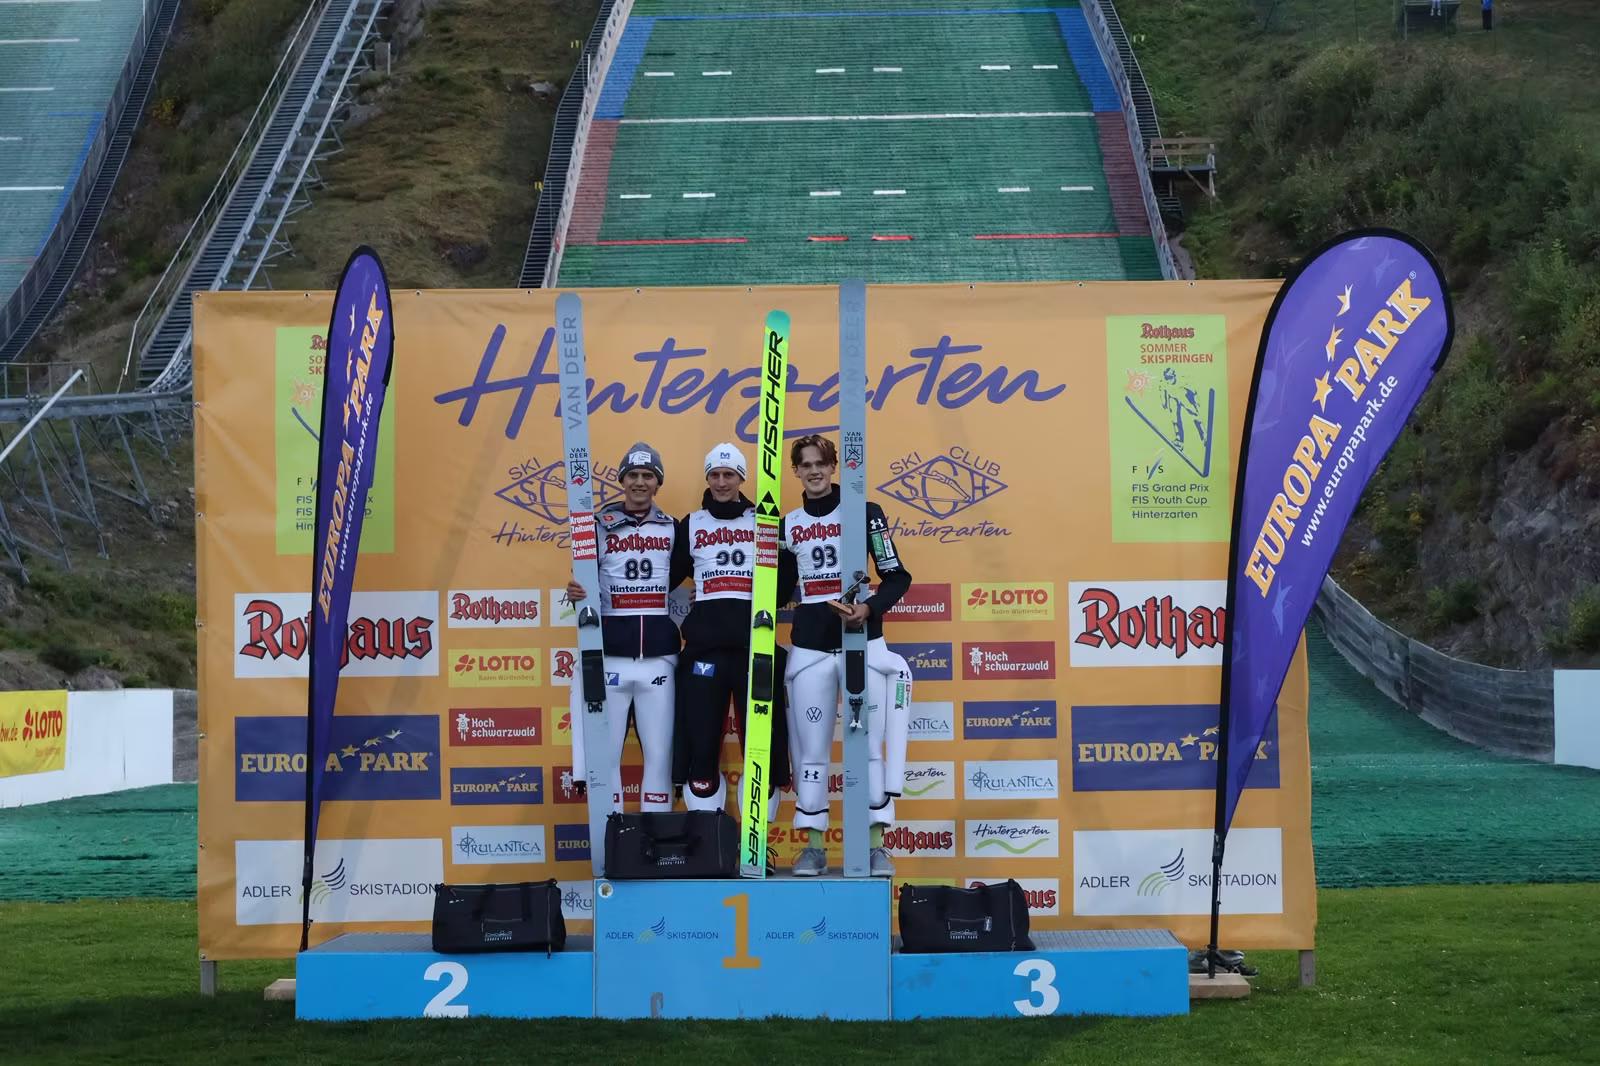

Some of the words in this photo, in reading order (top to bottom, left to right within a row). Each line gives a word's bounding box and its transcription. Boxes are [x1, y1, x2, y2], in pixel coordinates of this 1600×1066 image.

[1140, 323, 1195, 341] Rothaus
[563, 316, 580, 375] DEER
[1141, 343, 1187, 353] SOMMER
[1141, 353, 1214, 364] SKISPRINGEN
[434, 323, 1067, 443] Hnterzarten
[566, 385, 583, 430] VAN
[763, 330, 784, 481] FISCHER
[1244, 414, 1342, 598] EUROPA
[1334, 278, 1432, 403] PARK
[319, 439, 355, 623] EUROPA
[351, 291, 383, 423] PARK
[889, 451, 922, 475] SKI
[949, 445, 1001, 477] CLUB
[1301, 375, 1398, 547] www.europapark.de
[508, 457, 541, 480] SKI
[593, 462, 618, 482] UB
[339, 393, 374, 571] www.europapark.de
[1132, 483, 1149, 492] FIS
[1152, 483, 1185, 492] Grand
[1189, 483, 1209, 492] Prix
[296, 496, 313, 504] FIS
[1132, 495, 1149, 504] FIS
[1153, 495, 1182, 504] Youth
[1185, 495, 1208, 507] Cup
[296, 508, 313, 516] FIS
[1132, 509, 1198, 519] Hinterzarten
[570, 514, 594, 526] Kronen
[491, 521, 571, 549] Hinterz
[571, 524, 595, 534] Zeitung
[757, 525, 778, 535] Kronen
[572, 538, 595, 549] Kronen
[605, 533, 671, 554] Rothaus
[694, 527, 755, 550] Rothau
[573, 547, 597, 557] Zeitung
[756, 547, 777, 556] Kronen
[812, 544, 839, 570] 93
[624, 558, 653, 581] 89
[802, 571, 842, 581] Hinterzar
[610, 585, 666, 593] Hinterzarten
[992, 589, 1048, 605] LOTTO
[451, 593, 538, 624] Rothaus
[240, 599, 434, 671] Roaus
[479, 656, 535, 671] LOTTO
[916, 658, 948, 668] PARK
[985, 651, 1008, 661] Hoch
[985, 661, 1049, 671] schwarzwald
[35, 710, 62, 739] LOTTO
[471, 717, 494, 727] Hoch
[966, 718, 1012, 728] EUROPA
[1020, 717, 1052, 727] PARK
[0, 722, 18, 742] bw.de
[471, 727, 535, 737] schwarzwald
[1078, 742, 1182, 762] EUROPA
[1199, 741, 1268, 760] PK
[241, 753, 343, 772] EUROA
[360, 752, 429, 771] PARK
[453, 783, 499, 793] EUROPA
[507, 783, 538, 792] PARK
[982, 775, 1054, 790] RULANTICA
[748, 760, 762, 867] FISCHER
[790, 827, 843, 843] LOTO
[973, 823, 1051, 838] Hinterzarten
[470, 840, 542, 855] RULANTICA
[557, 840, 592, 849] EURO
[880, 826, 953, 854] othaus
[1080, 876, 1130, 888] ADLER
[242, 885, 292, 898] ADLER
[350, 884, 437, 896] SKISTADION
[605, 931, 634, 940] ADLER
[667, 931, 719, 940] SKISTADION
[721, 893, 761, 968] 1
[765, 931, 794, 940] ADLER
[828, 932, 879, 940] SKISTADION
[424, 961, 469, 1017] 2
[1013, 959, 1060, 1017] 3
